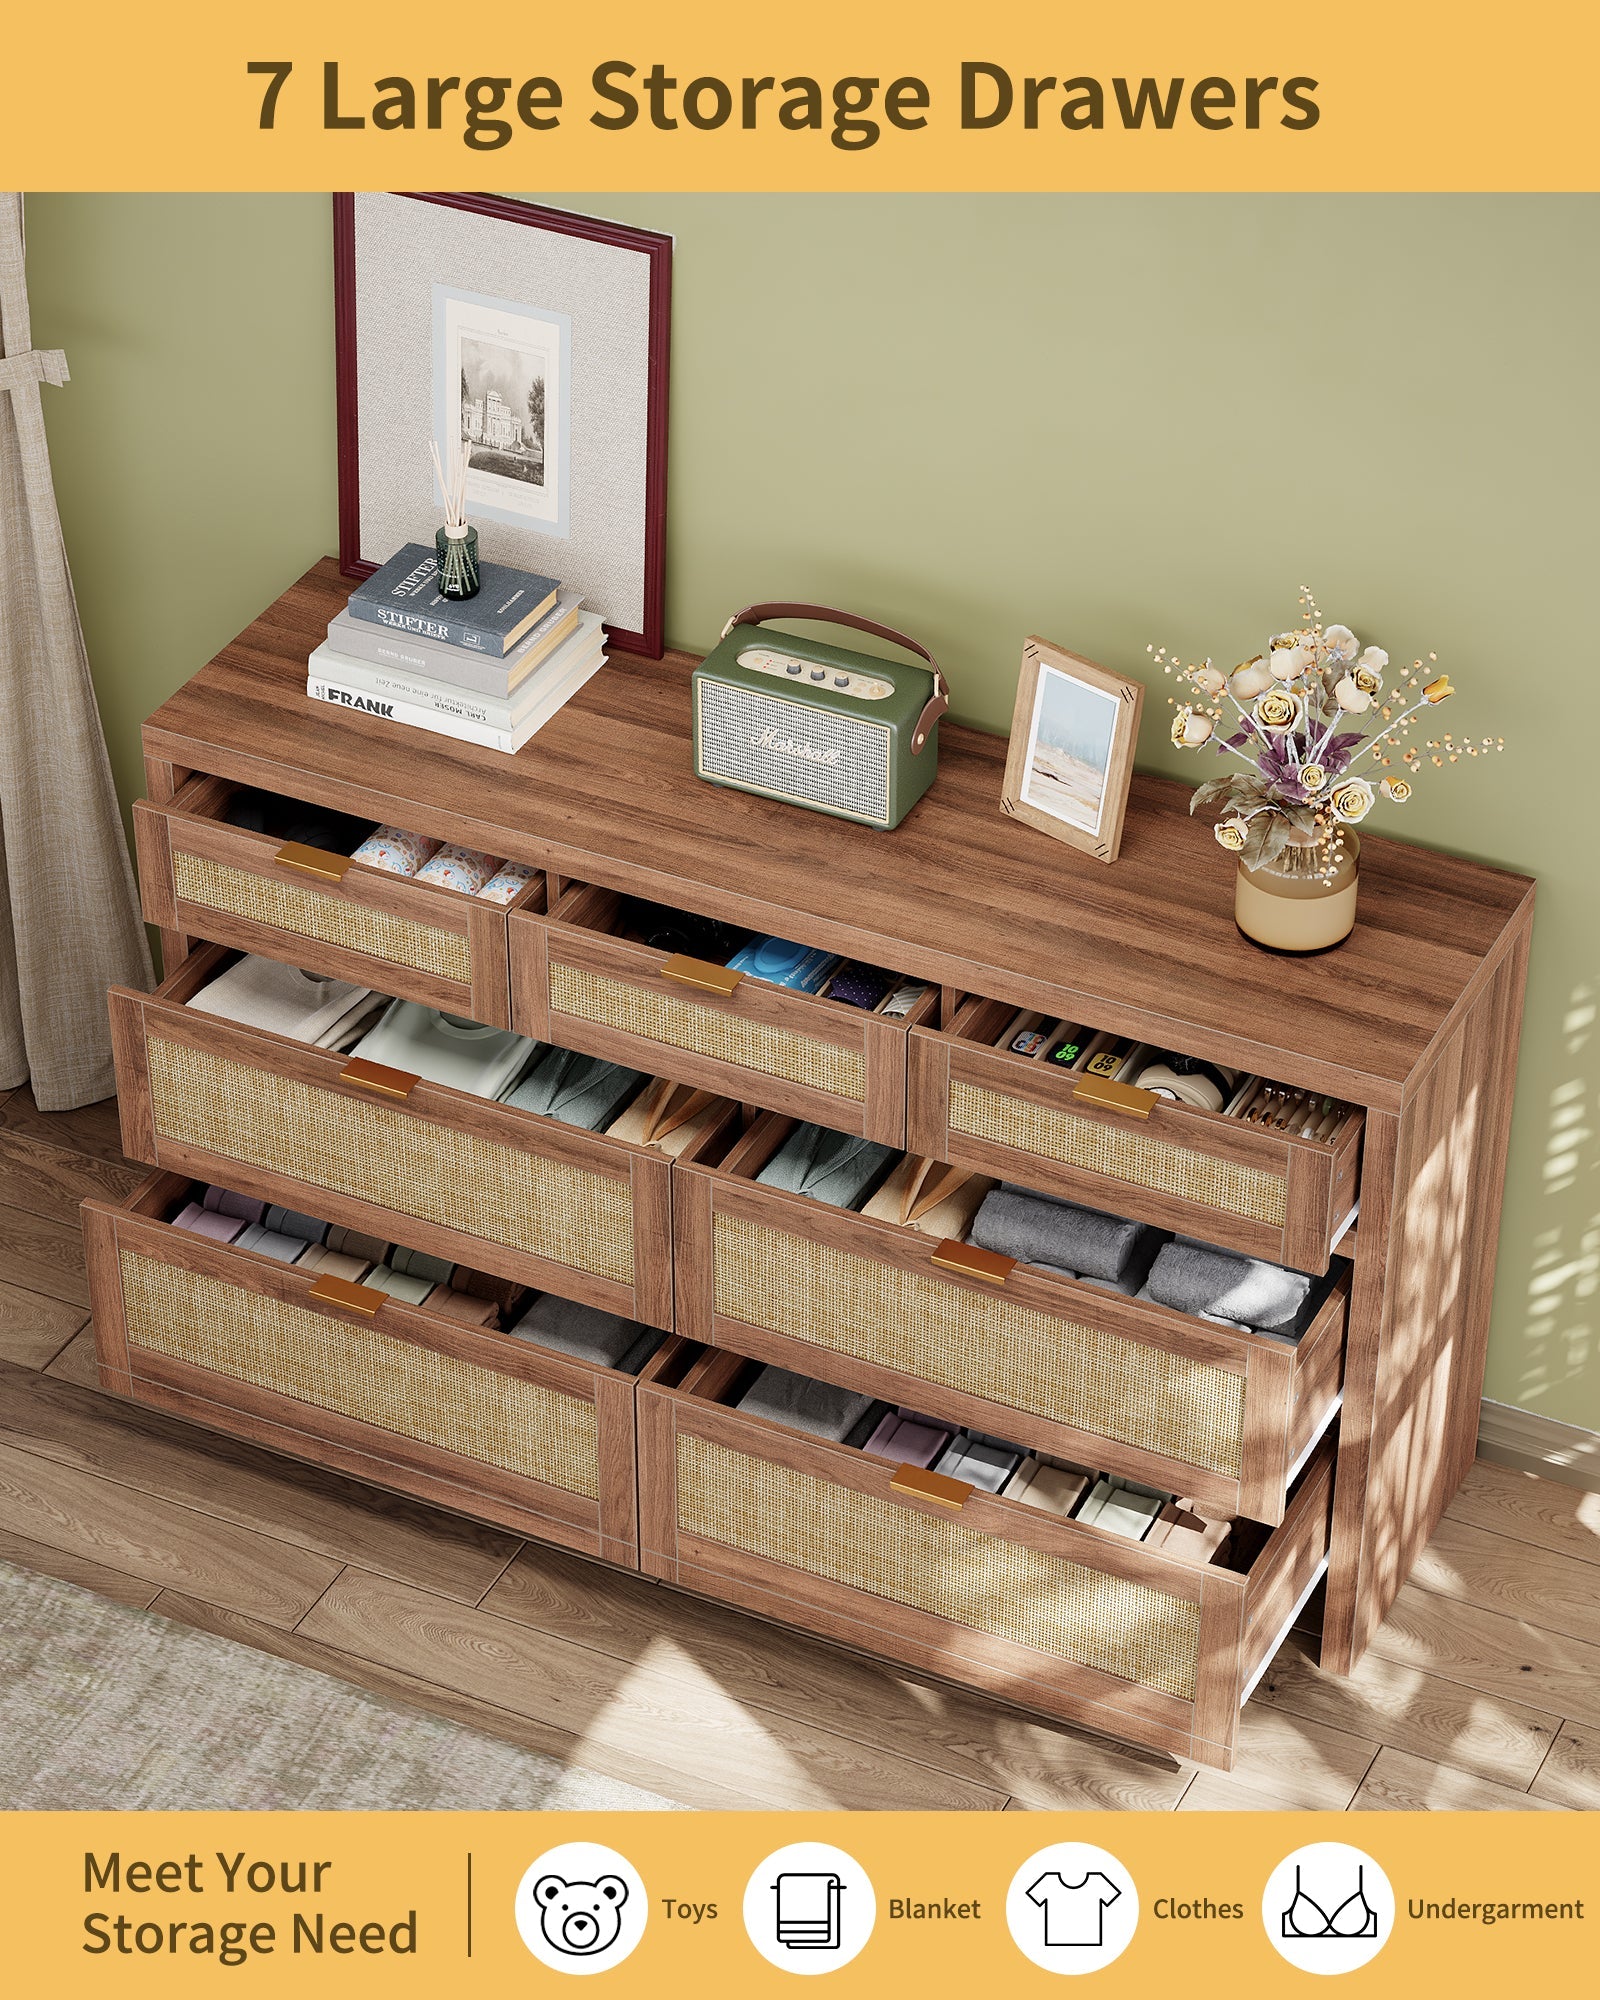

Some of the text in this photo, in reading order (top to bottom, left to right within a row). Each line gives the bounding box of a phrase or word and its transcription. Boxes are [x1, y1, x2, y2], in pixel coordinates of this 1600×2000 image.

[391, 557, 438, 597] STIFTER
[377, 608, 449, 638] STIFTER
[375, 677, 391, 688] Zeit
[391, 683, 411, 693] neue
[412, 689, 429, 698] eine
[328, 688, 394, 718] FRANK
[444, 697, 487, 715] Architektur
[434, 702, 487, 722] CARL MOSER
[750, 726, 840, 765] Marshall
[1062, 1043, 1080, 1053] 10
[1055, 1051, 1075, 1061] 09
[1100, 1055, 1117, 1064] 10
[1093, 1062, 1114, 1072] 09
